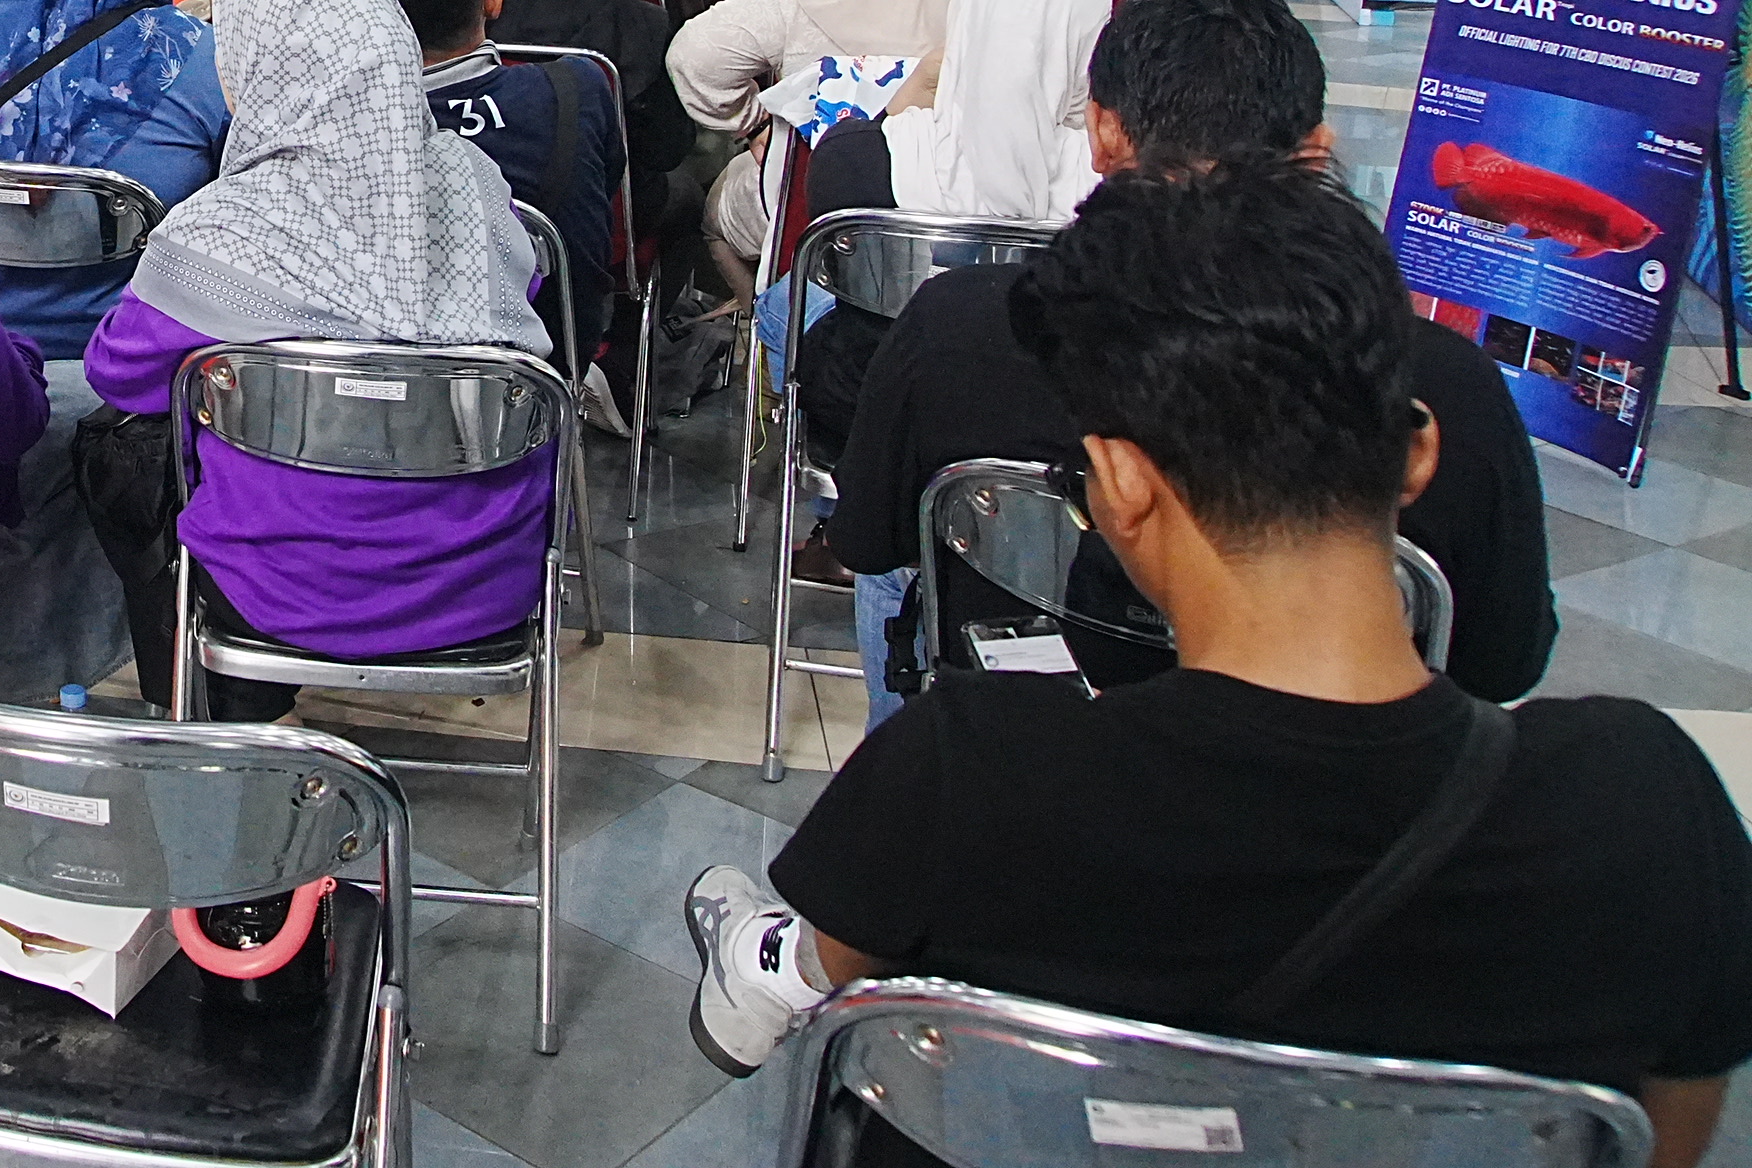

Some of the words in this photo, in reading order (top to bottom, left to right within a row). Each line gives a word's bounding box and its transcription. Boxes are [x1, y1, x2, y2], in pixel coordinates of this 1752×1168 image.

[1570, 12, 1634, 36] COLOR
[1638, 24, 1725, 51] BOOSTER
[1458, 24, 1499, 44] OFFICIAL
[1498, 33, 1539, 52] LIGHTING
[1539, 40, 1560, 57] FOR
[1559, 43, 1577, 60] 7TH
[1577, 48, 1598, 64] CBD
[1597, 52, 1633, 71] DISCUS
[1631, 59, 1676, 80] CONTEST
[447, 94, 506, 136] 31
[1407, 210, 1460, 234] SOLAR
